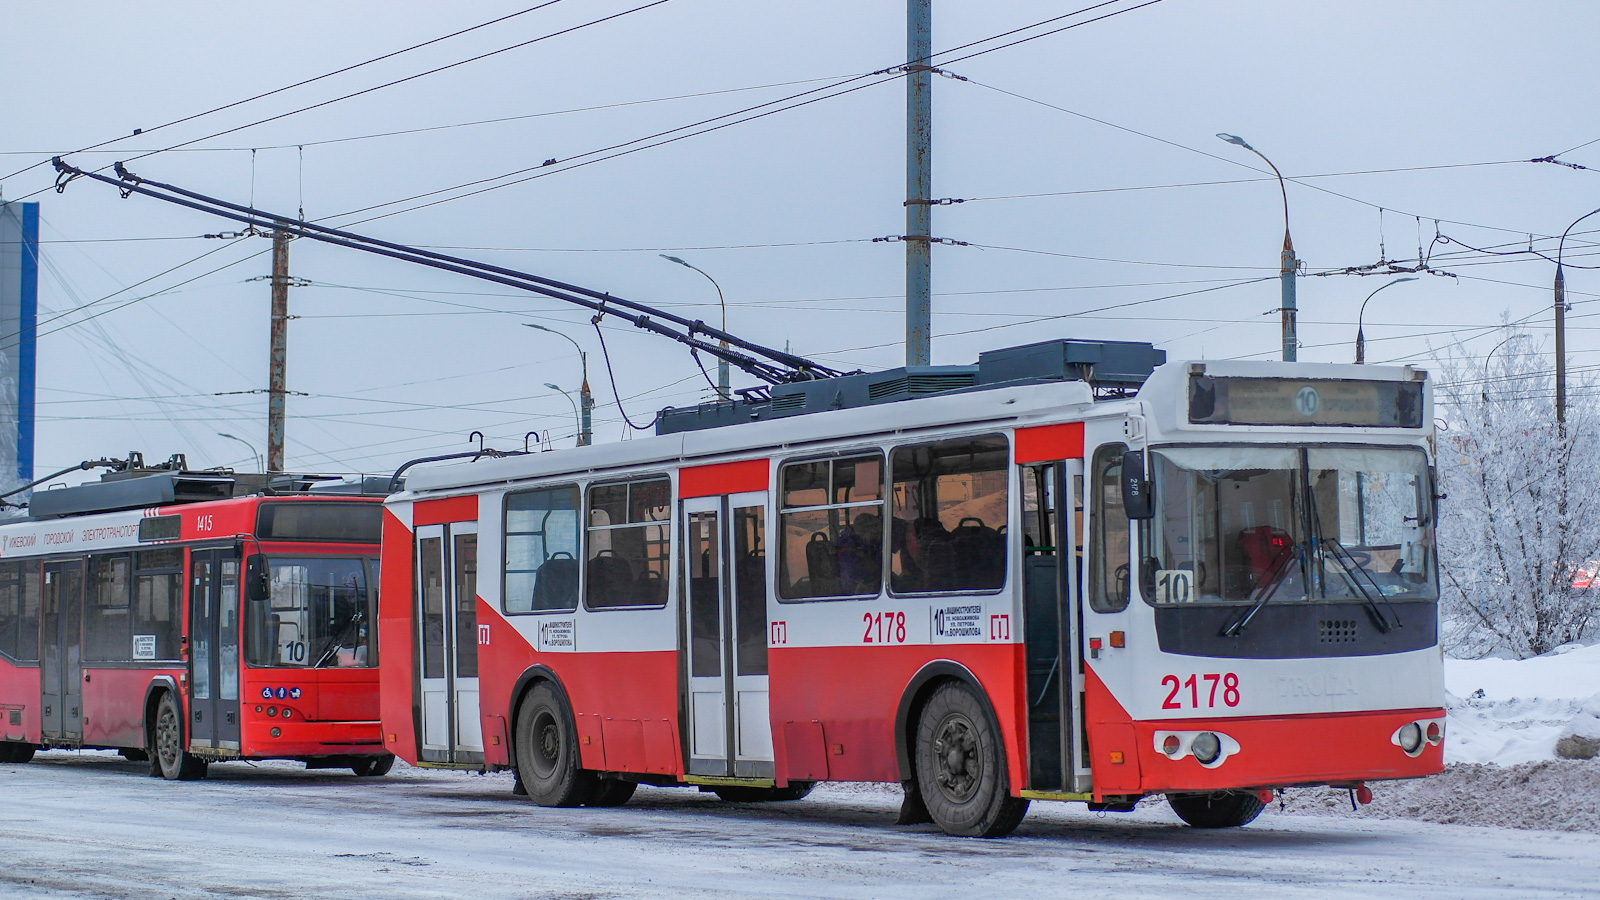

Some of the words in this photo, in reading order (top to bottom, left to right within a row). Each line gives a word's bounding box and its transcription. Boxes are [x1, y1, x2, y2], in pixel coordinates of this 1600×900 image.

[1298, 391, 1319, 413] 10
[1130, 478, 1139, 496] 2178
[197, 514, 213, 531] 1415
[9, 533, 37, 548] ИЖЕВСКИЙ
[43, 529, 75, 546] ГОРОДСКОЙ
[82, 524, 140, 542] ЭЛЕКТРОТРАНСПОРТ
[1159, 573, 1189, 603] 10
[863, 611, 906, 643] 2178
[934, 608, 945, 636] 10
[541, 623, 549, 645] 10
[286, 641, 305, 662] 10
[1161, 672, 1240, 709] 2178
